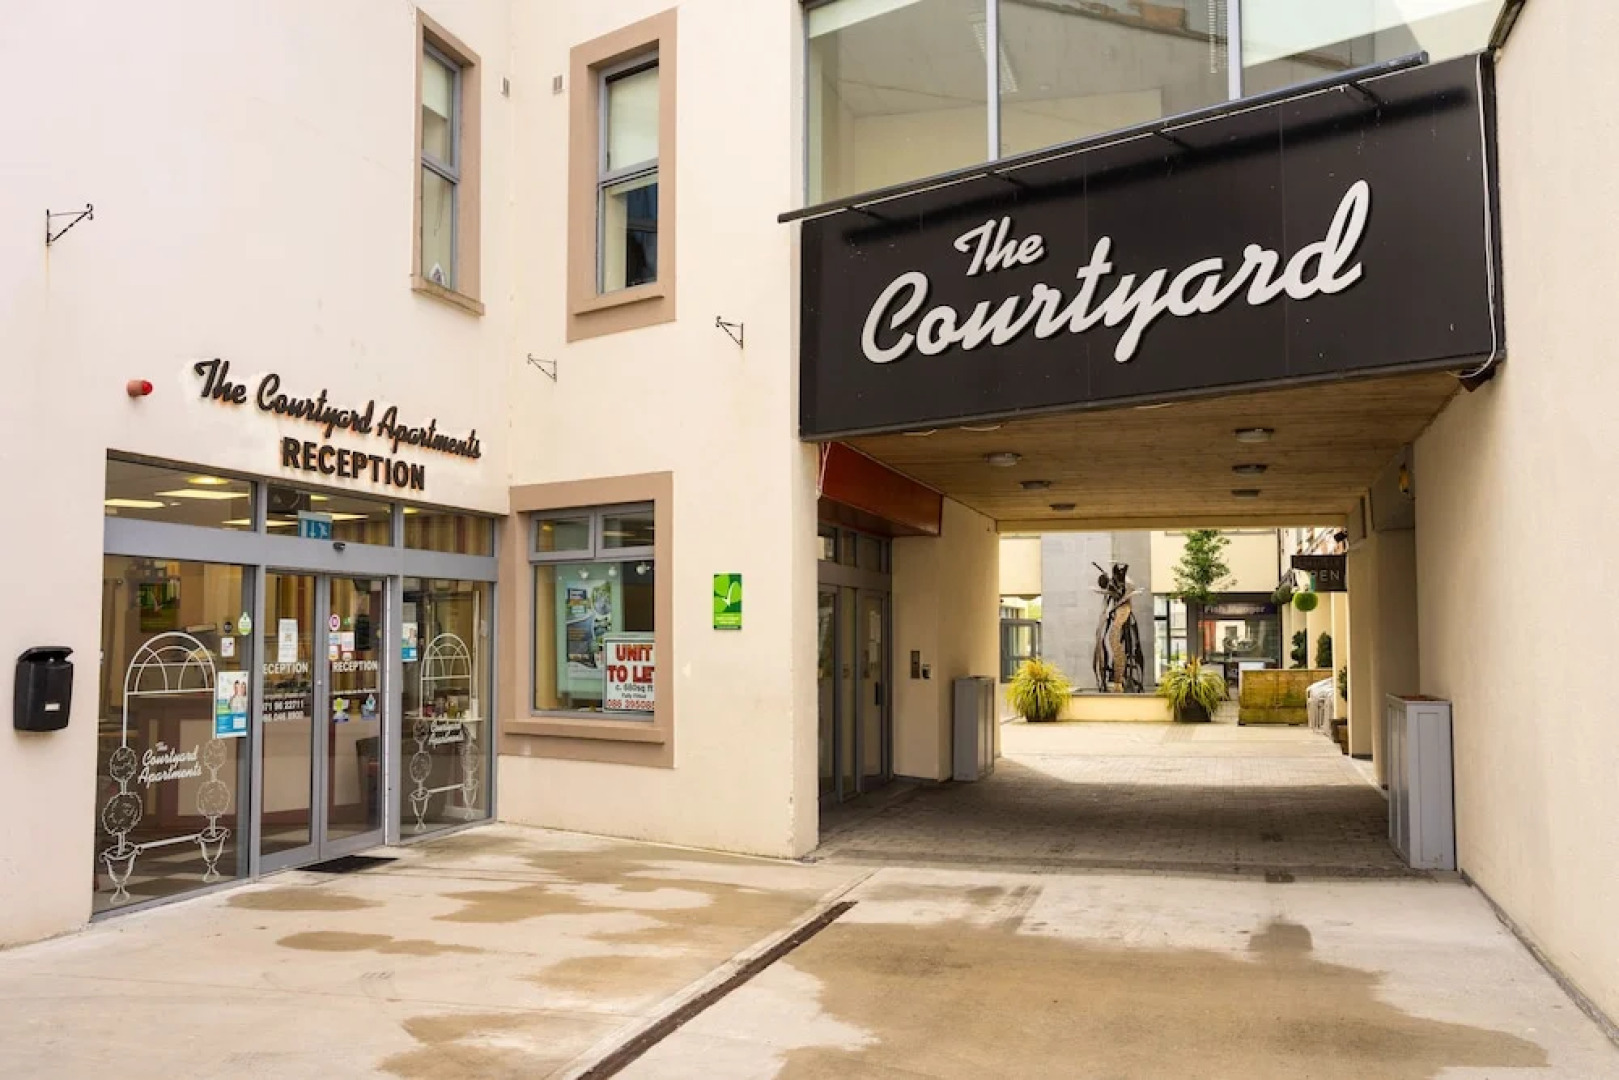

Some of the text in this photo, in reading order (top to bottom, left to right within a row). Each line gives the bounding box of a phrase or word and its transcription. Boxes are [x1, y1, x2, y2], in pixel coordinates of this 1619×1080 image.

[954, 216, 1045, 276] The
[860, 179, 1371, 364] Courtyard
[194, 358, 481, 459] The Courtyard Apartments
[281, 436, 425, 490] RECEPTION
[615, 644, 653, 661] UNIT
[262, 662, 309, 674] ECEPTION
[333, 660, 378, 673] RECEPTION
[607, 665, 654, 683] TO LE
[142, 745, 199, 767] Courtyard
[137, 761, 202, 789] Apartments
